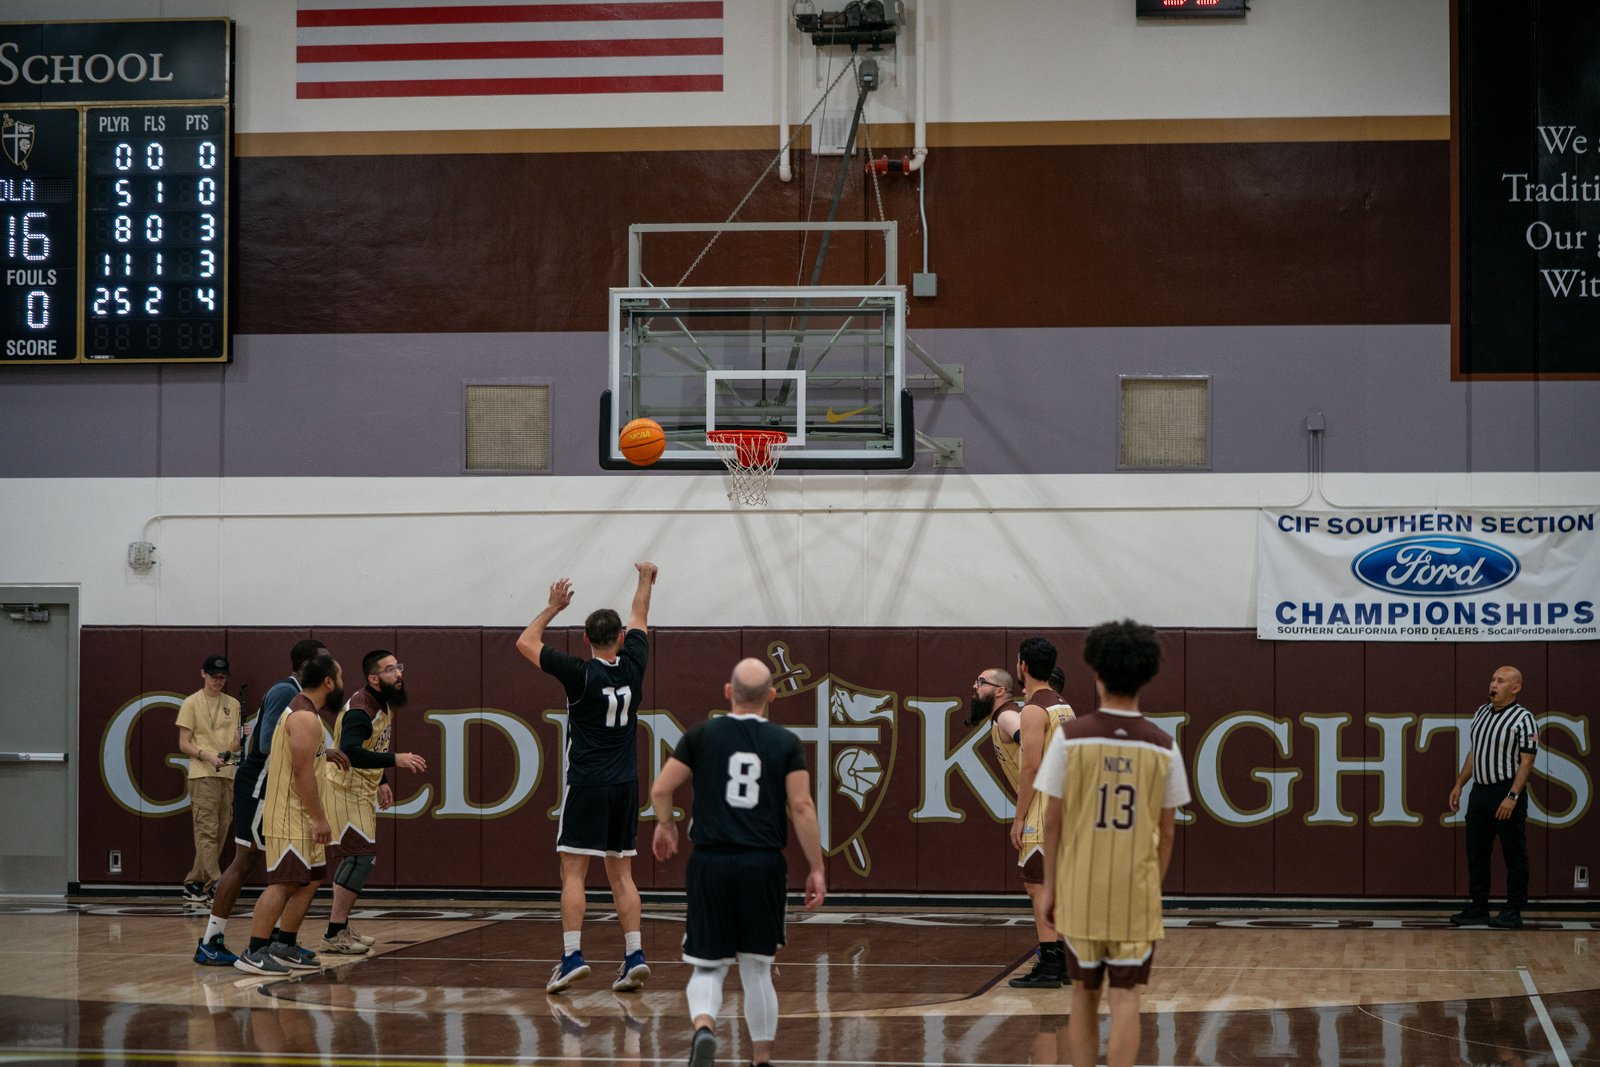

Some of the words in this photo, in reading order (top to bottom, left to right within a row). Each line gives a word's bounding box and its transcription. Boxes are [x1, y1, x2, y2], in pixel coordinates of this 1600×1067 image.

[99, 116, 130, 133] PLYR
[144, 115, 166, 132] FLS
[186, 114, 209, 131] PTS
[1537, 126, 1587, 154] We
[115, 143, 132, 171] 0
[146, 142, 164, 170] 0
[198, 141, 216, 169] 0
[115, 179, 132, 207] 5
[198, 177, 216, 205] 0
[8, 211, 51, 261] 16
[115, 215, 132, 243] 8
[146, 214, 163, 243] 0
[200, 213, 216, 242] 3
[1525, 221, 1588, 250] Our
[7, 269, 57, 286] FOULS
[103, 254, 132, 276] 11
[200, 249, 215, 278] 3
[27, 290, 50, 329] 0
[93, 286, 131, 315] 25
[145, 286, 162, 315] 2
[197, 287, 215, 312] 4
[6, 339, 57, 356] SCORE
[1278, 514, 1319, 533] CIF
[1326, 514, 1472, 535] SOUTHERN
[1481, 513, 1594, 534] SECTION
[1385, 545, 1486, 586] Ford
[1275, 600, 1595, 626] CHAMPIONSHIPS
[1277, 626, 1333, 635] SOUTHERN
[1336, 626, 1397, 635] CALIFORNIA
[1400, 627, 1429, 635] FORD
[1431, 627, 1479, 635] DEALERS
[1487, 626, 1597, 635] SoCalFordDealers.com
[602, 685, 632, 728] 11
[1103, 755, 1134, 775] NICK
[726, 751, 761, 809] 8
[1094, 782, 1138, 831] 13
